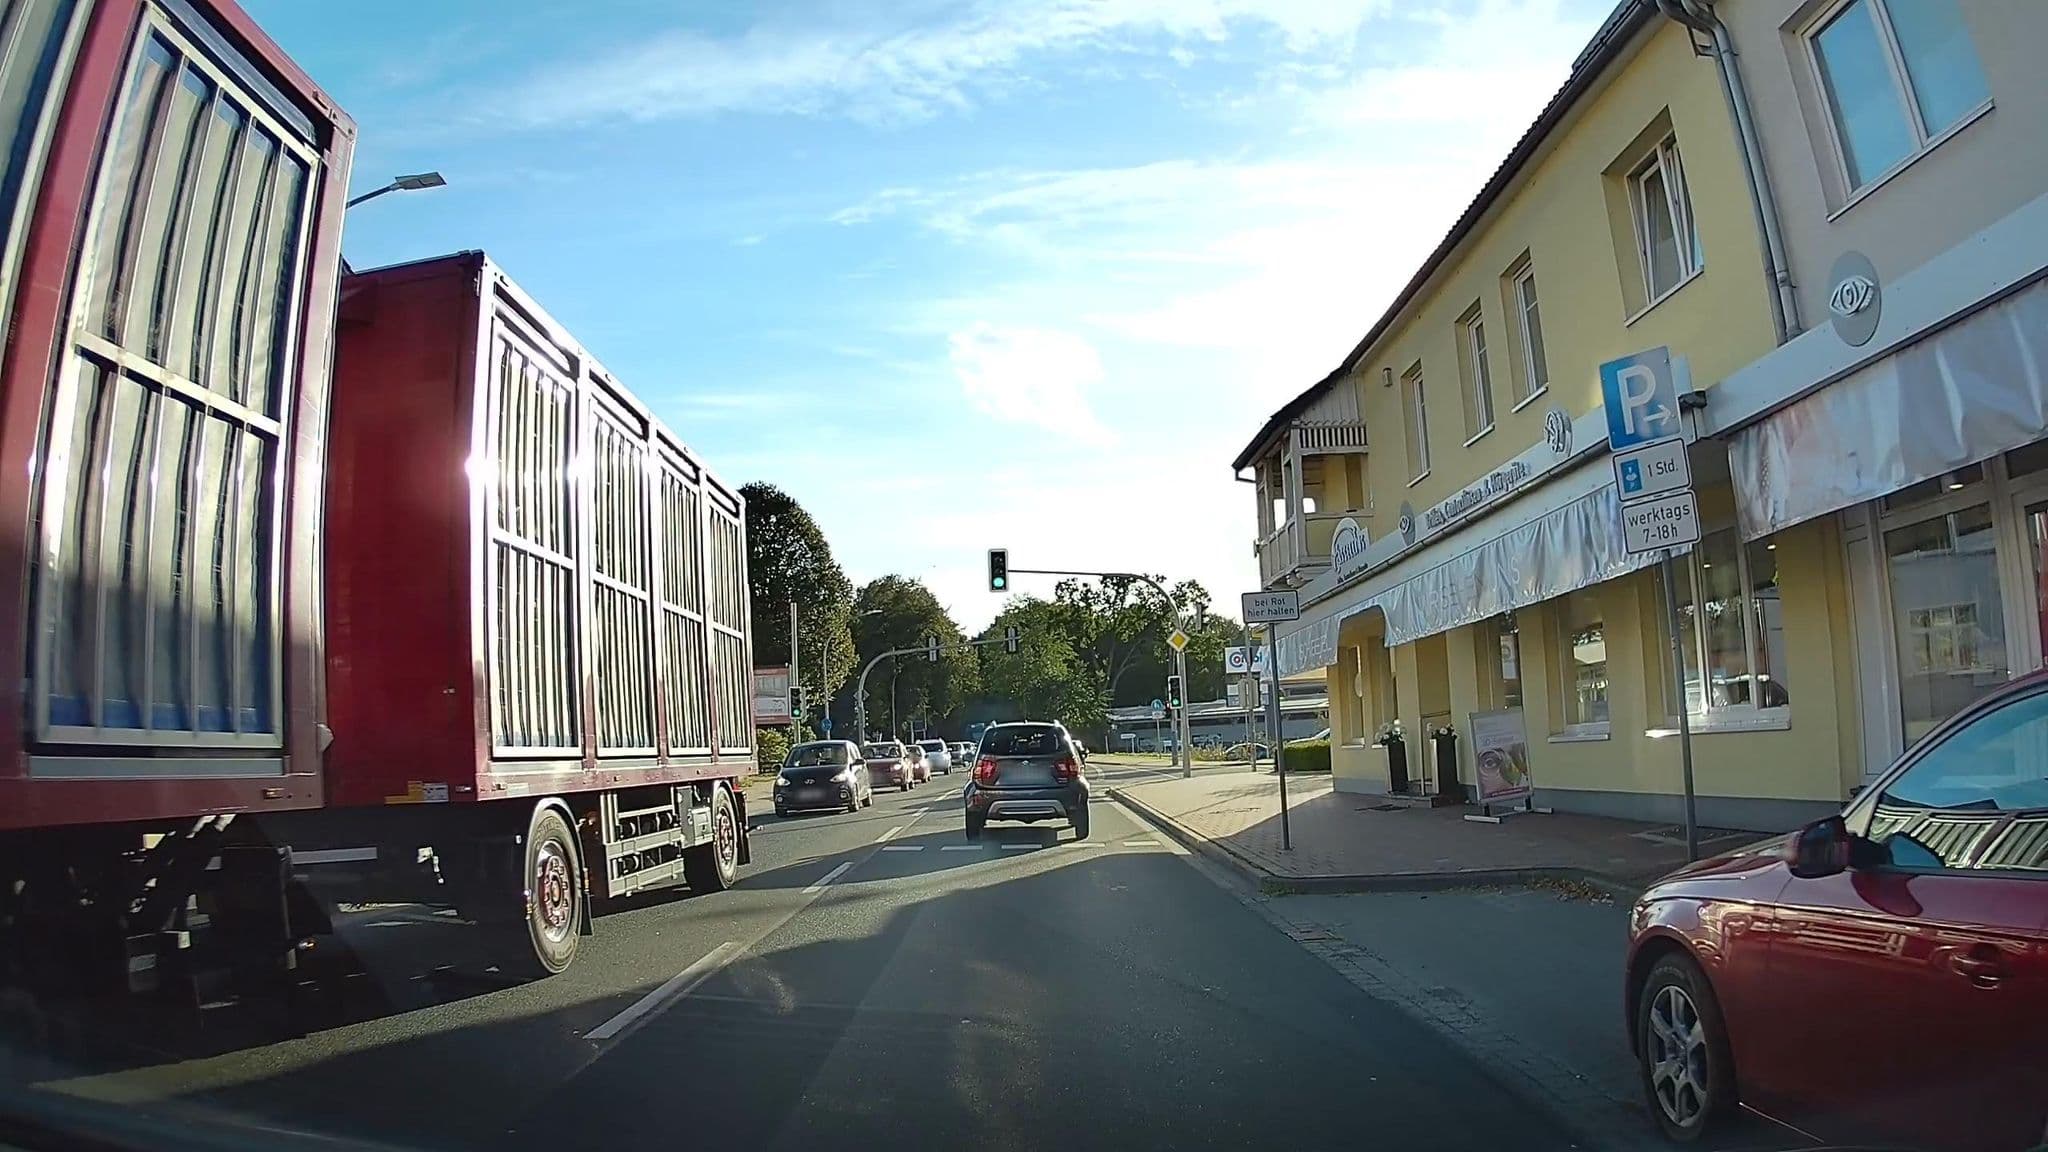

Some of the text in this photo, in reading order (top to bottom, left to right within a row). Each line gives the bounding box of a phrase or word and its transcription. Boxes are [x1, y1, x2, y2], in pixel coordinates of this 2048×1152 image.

[1616, 364, 1657, 435] P
[1647, 457, 1679, 477] 1 Std.
[1628, 504, 1690, 527] werktags
[1247, 606, 1295, 617] hier halten
[1254, 597, 1286, 607] bei Rot
